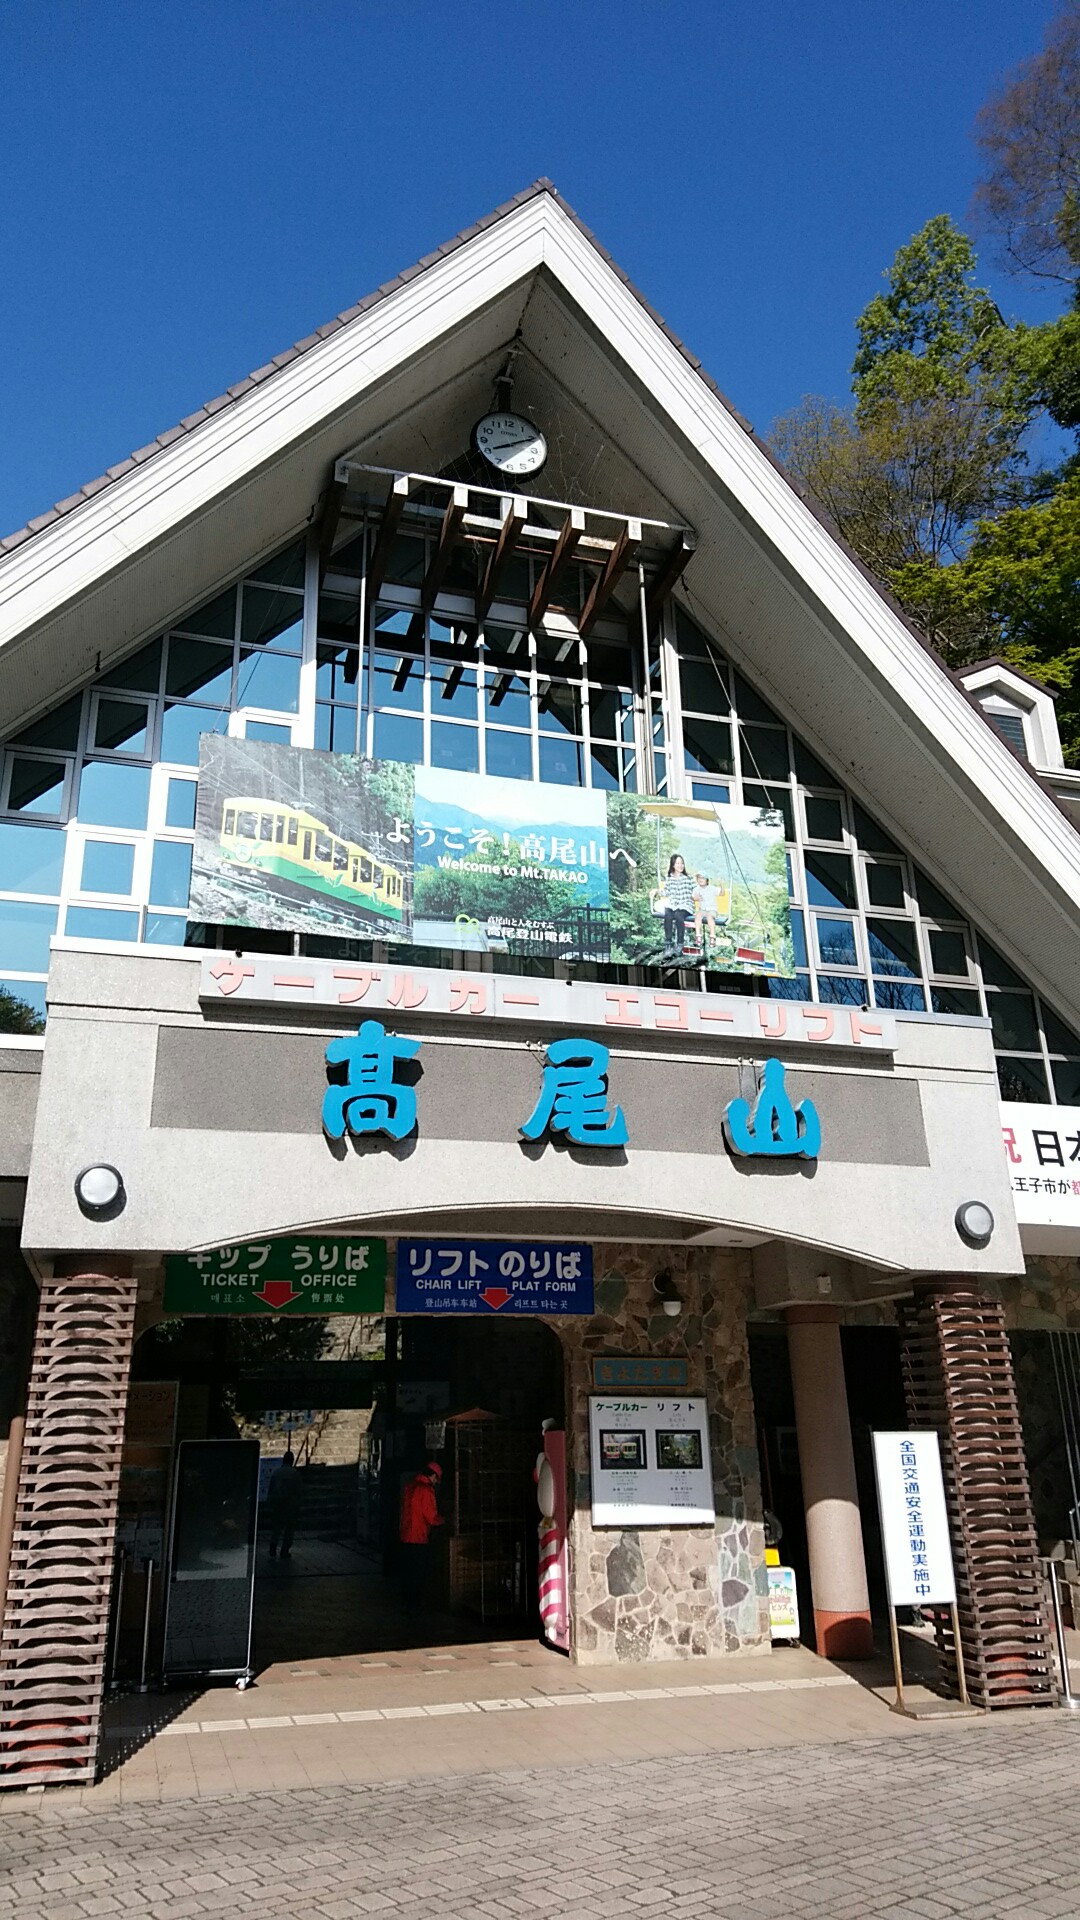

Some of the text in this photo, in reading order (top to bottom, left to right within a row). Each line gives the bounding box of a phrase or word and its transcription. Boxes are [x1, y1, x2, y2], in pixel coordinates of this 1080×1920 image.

[504, 420, 514, 428] 12
[483, 427, 494, 435] 10
[480, 436, 488, 444] 9
[483, 447, 492, 455] 8
[530, 447, 538, 455] 3
[494, 457, 502, 465] 7
[506, 463, 514, 471] 6
[519, 463, 527, 471] 5
[437, 855, 589, 885] Welcome to Mt.TAKAO
[487, 926, 574, 944] 高尾登山電鉄
[209, 960, 540, 1015] ケーブルカー
[291, 1244, 370, 1271] うりば
[409, 1248, 582, 1280] リフト のりば
[200, 1273, 358, 1287] TICKET OFFICE
[415, 1279, 577, 1293] CHAIR LIFT PLAT FORM
[513, 1297, 539, 1309] 리프트
[595, 1402, 696, 1412] ケーブルカー リフト
[899, 1439, 931, 1597] 全国交通安全運動実施中
